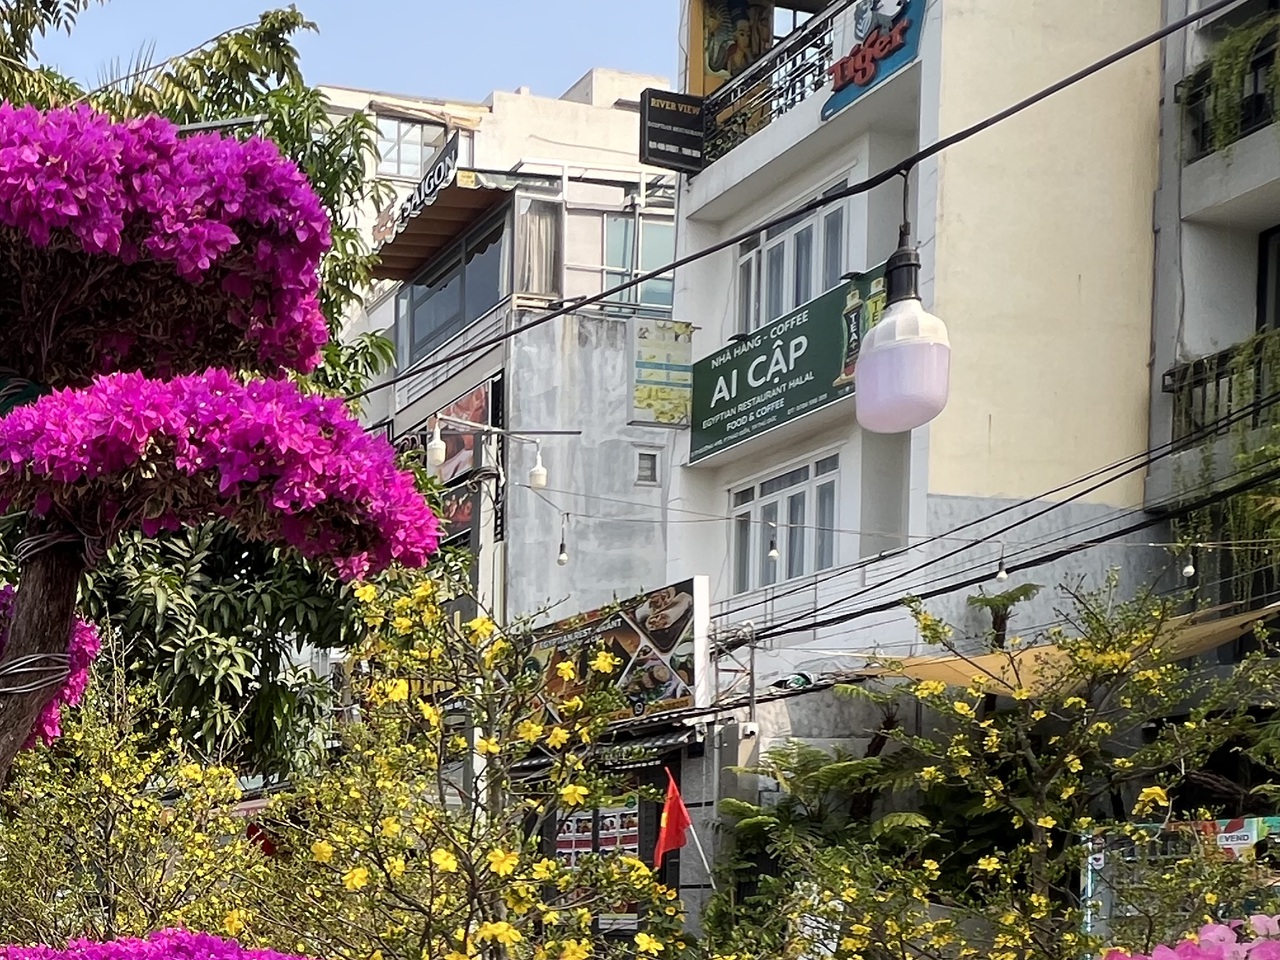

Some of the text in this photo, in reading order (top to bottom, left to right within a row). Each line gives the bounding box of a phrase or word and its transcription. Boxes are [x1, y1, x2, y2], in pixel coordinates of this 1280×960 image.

[827, 18, 910, 92] Tiger
[650, 98, 701, 115] RIVER VIEW
[711, 351, 732, 369] NHÀ
[770, 309, 809, 339] COFFEE
[702, 407, 737, 429] EGYPTIAN
[737, 385, 788, 413] RESTAURANT
[788, 371, 815, 390] HALAL
[710, 369, 738, 408] AI
[747, 335, 808, 387] CẬP
[726, 415, 747, 431] FOOD
[756, 398, 785, 418] COFFEE
